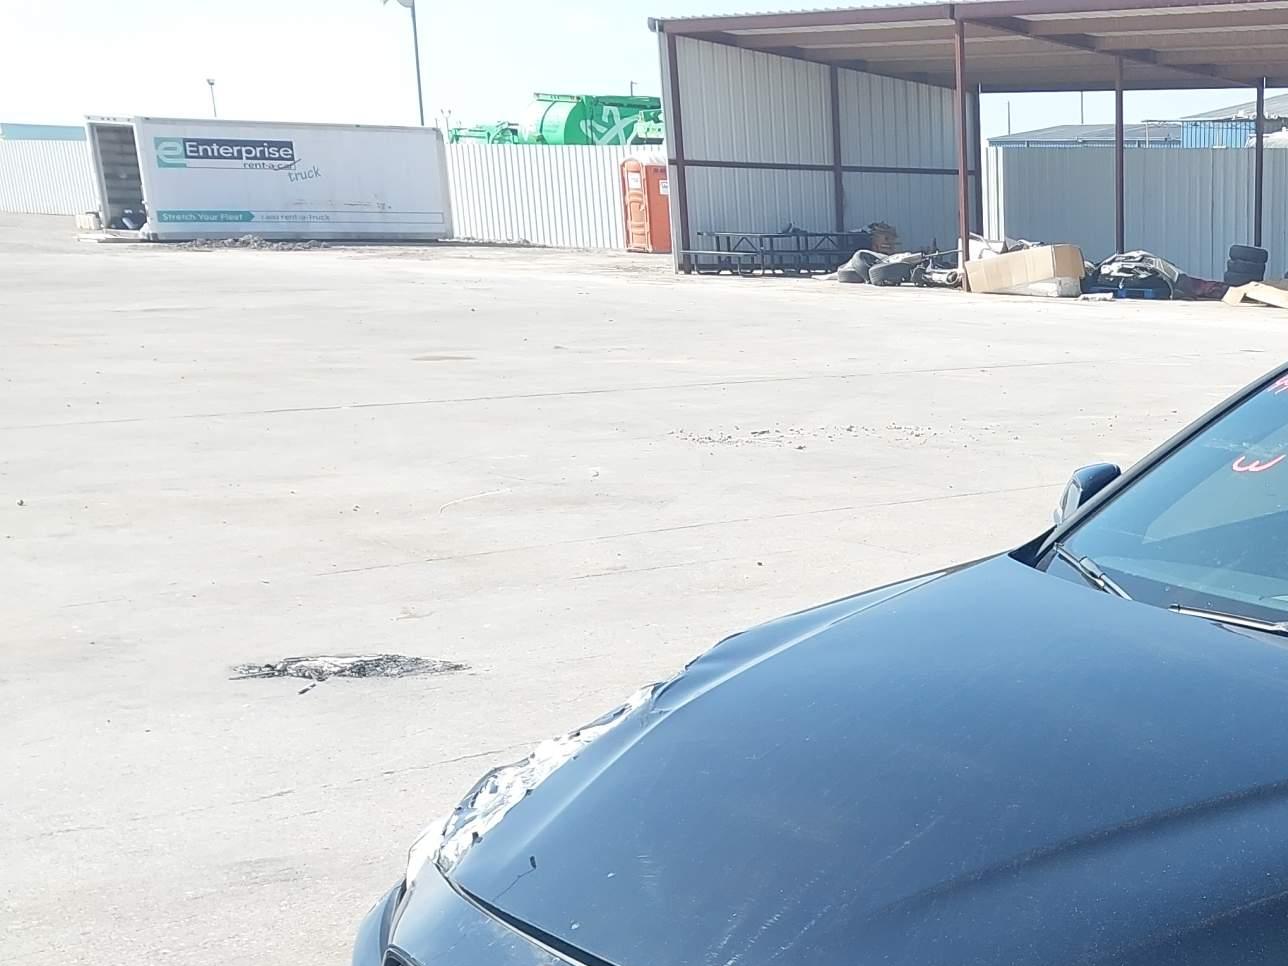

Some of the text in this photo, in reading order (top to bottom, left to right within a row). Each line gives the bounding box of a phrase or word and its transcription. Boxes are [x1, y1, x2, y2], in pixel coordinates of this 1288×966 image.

[185, 141, 294, 161] Enterprise
[287, 165, 321, 182] truck
[162, 212, 196, 221] Stretch
[198, 213, 218, 221] Your
